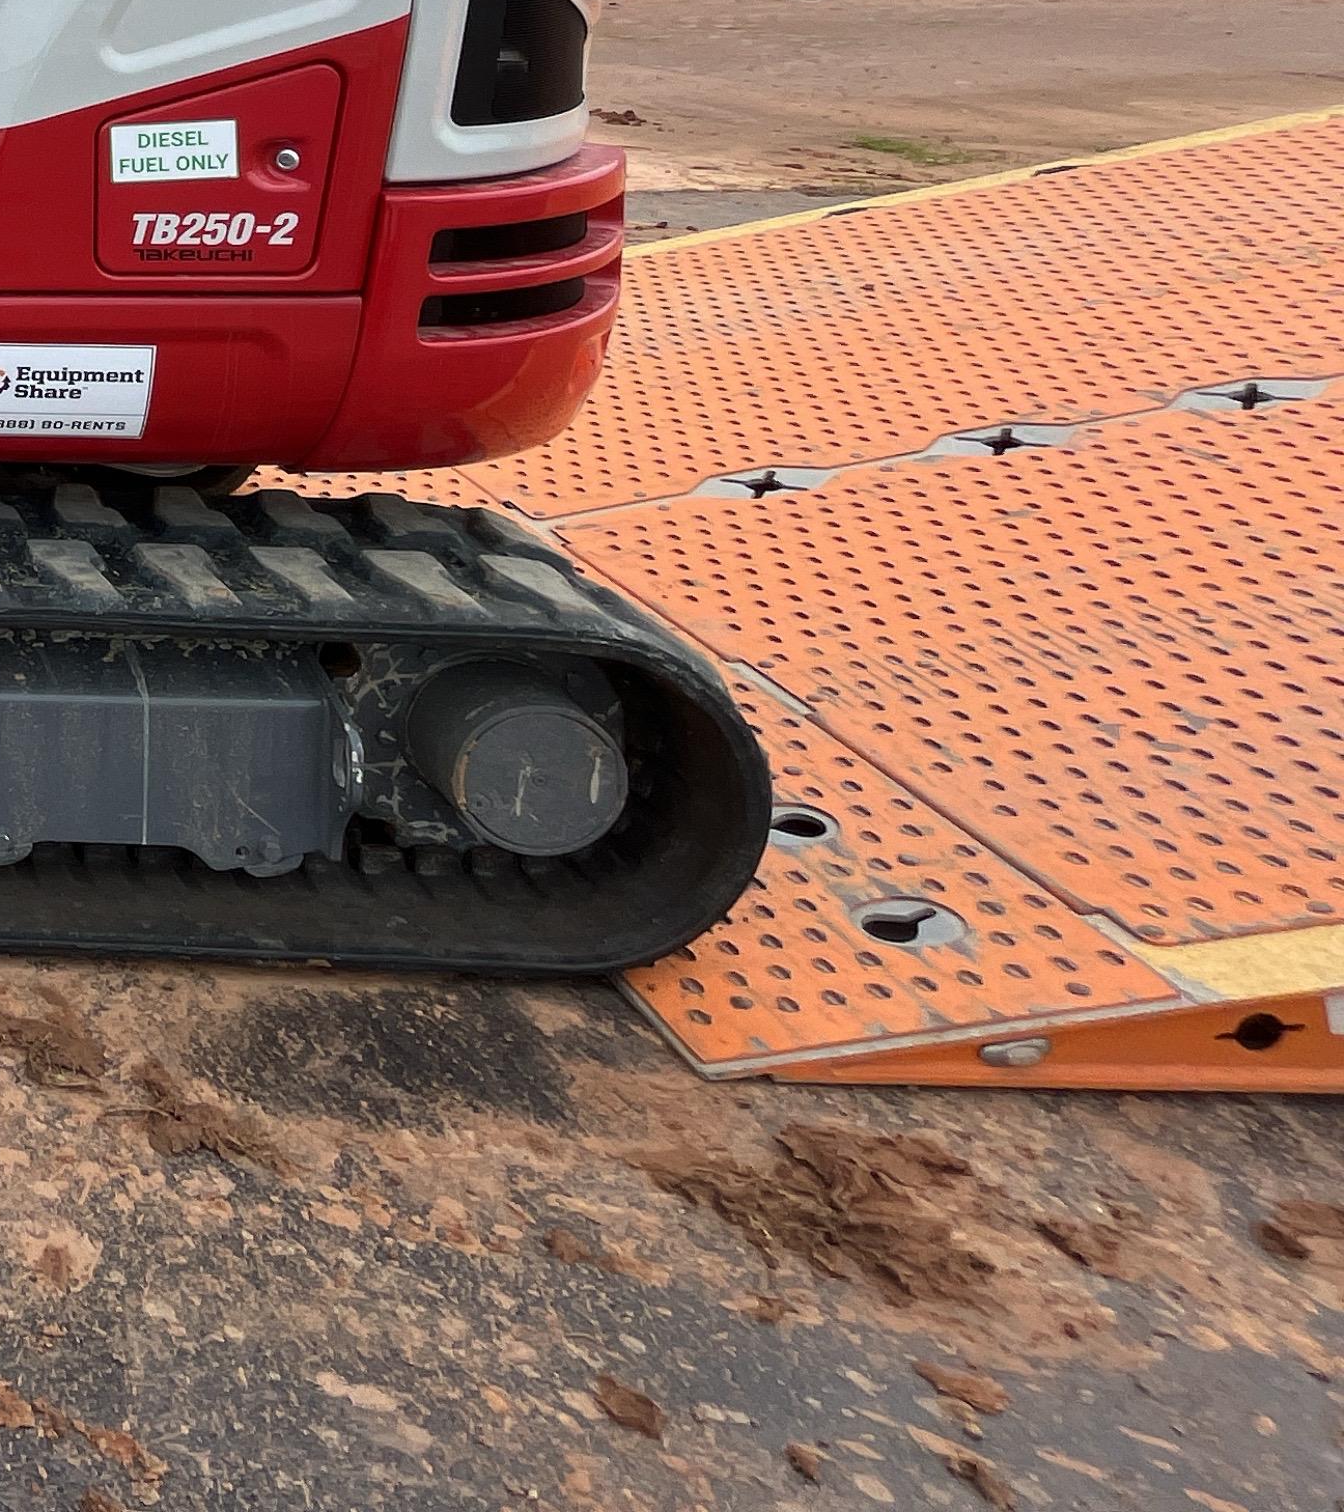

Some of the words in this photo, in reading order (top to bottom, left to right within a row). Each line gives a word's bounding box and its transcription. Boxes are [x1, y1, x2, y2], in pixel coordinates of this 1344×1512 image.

[137, 129, 210, 149] DIESEL
[118, 157, 171, 175] FUEL
[175, 153, 230, 172] ONLY
[131, 211, 300, 247] TB250-2
[15, 366, 145, 386] Equipment
[13, 384, 83, 400] Share
